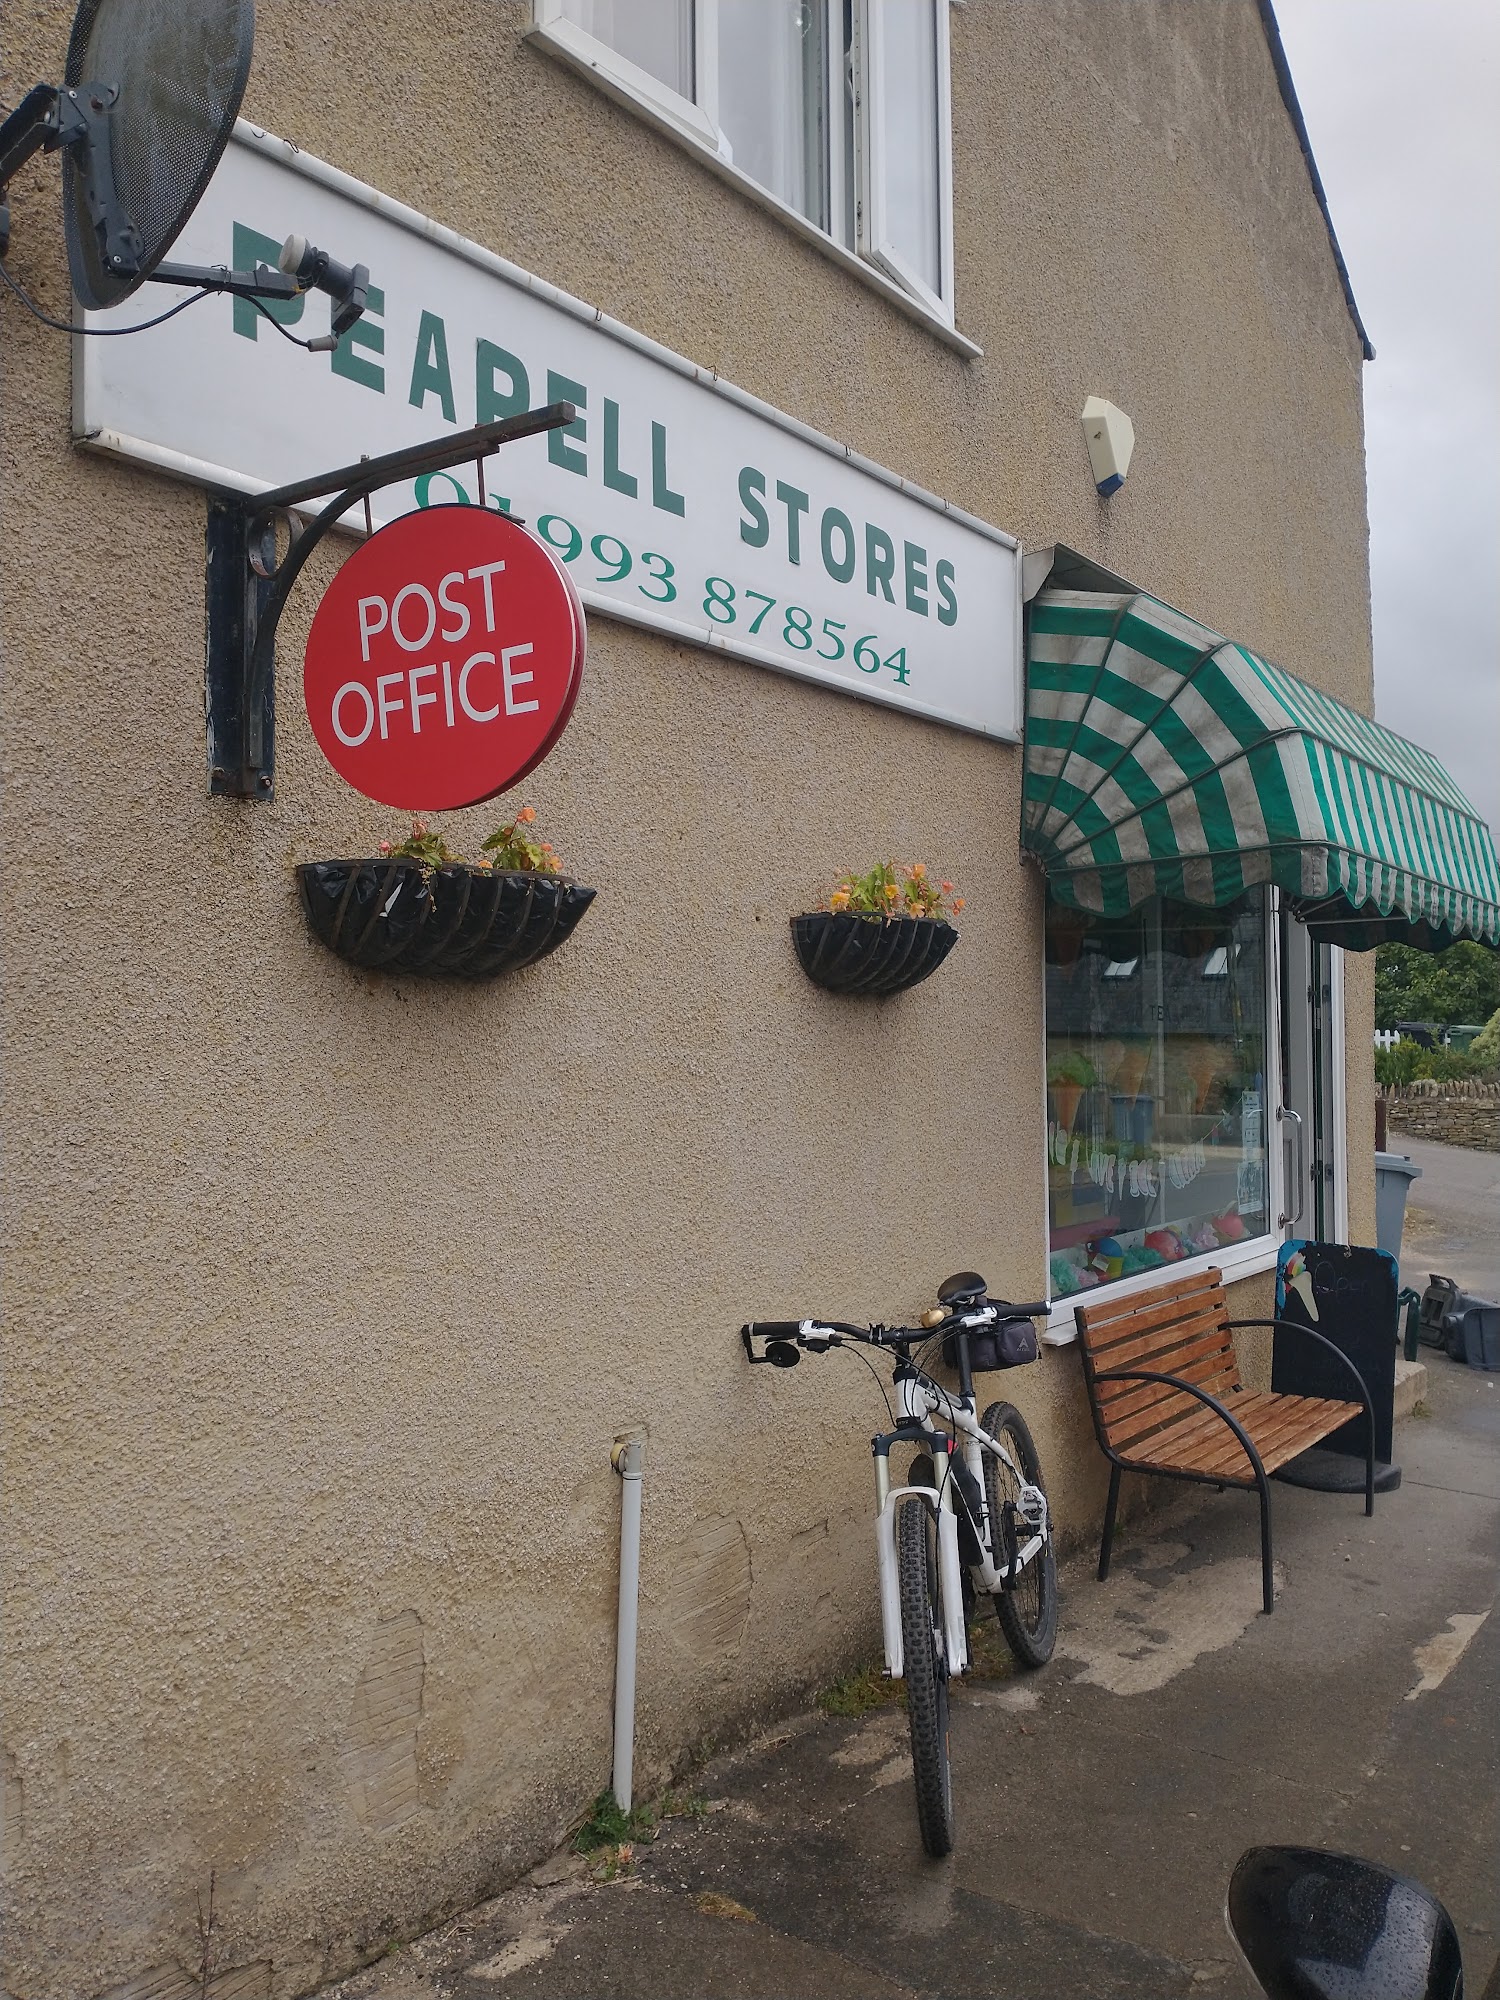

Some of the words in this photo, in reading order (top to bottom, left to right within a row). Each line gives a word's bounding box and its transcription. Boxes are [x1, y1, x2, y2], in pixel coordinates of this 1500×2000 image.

[232, 221, 686, 518] PEARELL
[738, 466, 958, 627] STORES
[358, 560, 506, 662] POST
[702, 576, 911, 686] 878564
[331, 642, 540, 747] OFFICE
